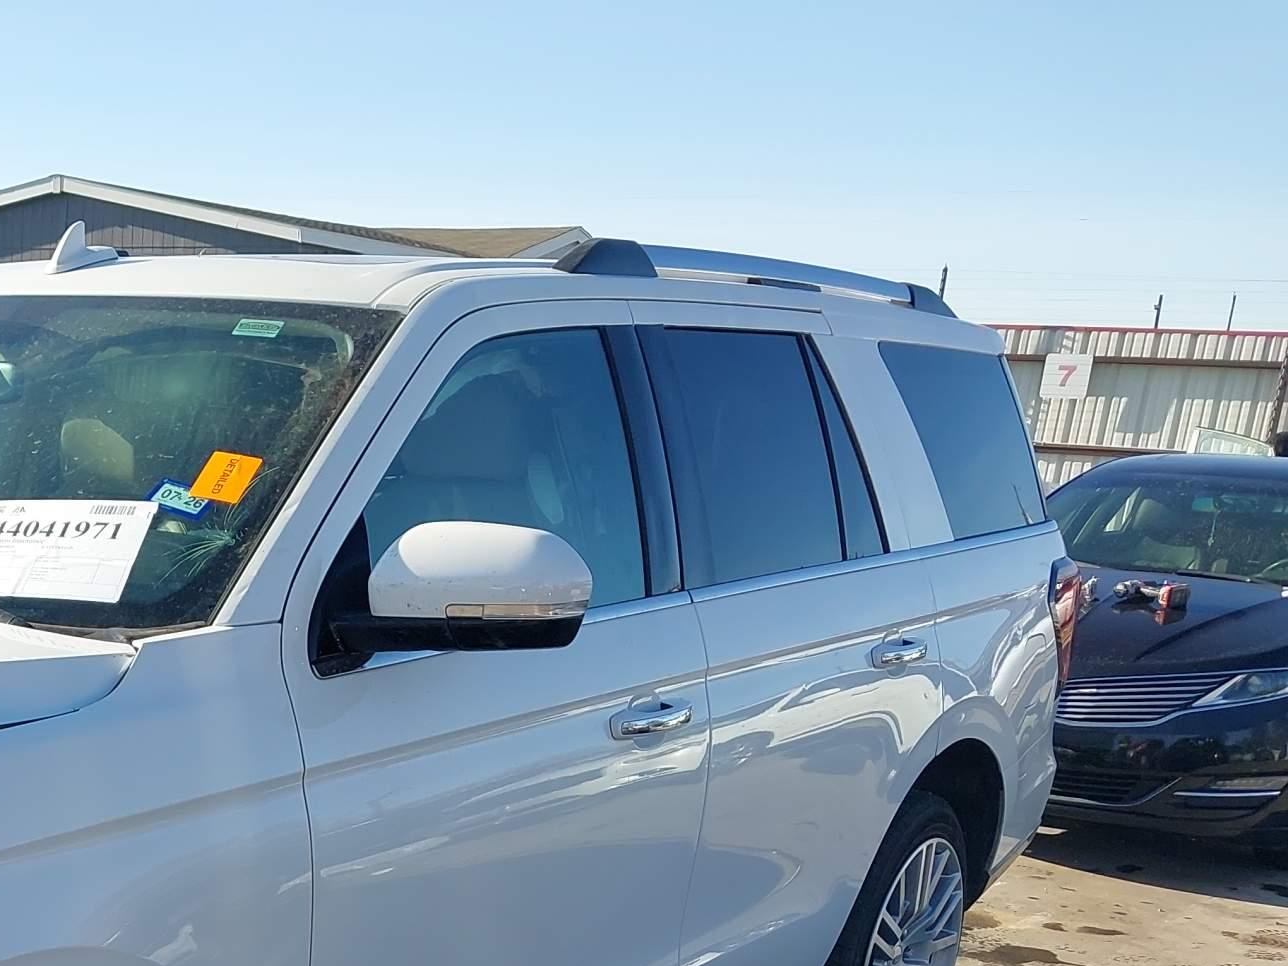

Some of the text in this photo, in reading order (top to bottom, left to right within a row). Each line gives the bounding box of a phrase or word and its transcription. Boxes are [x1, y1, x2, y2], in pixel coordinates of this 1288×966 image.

[1057, 364, 1078, 387] 7
[211, 458, 240, 495] DETAILED
[183, 496, 206, 509] 26
